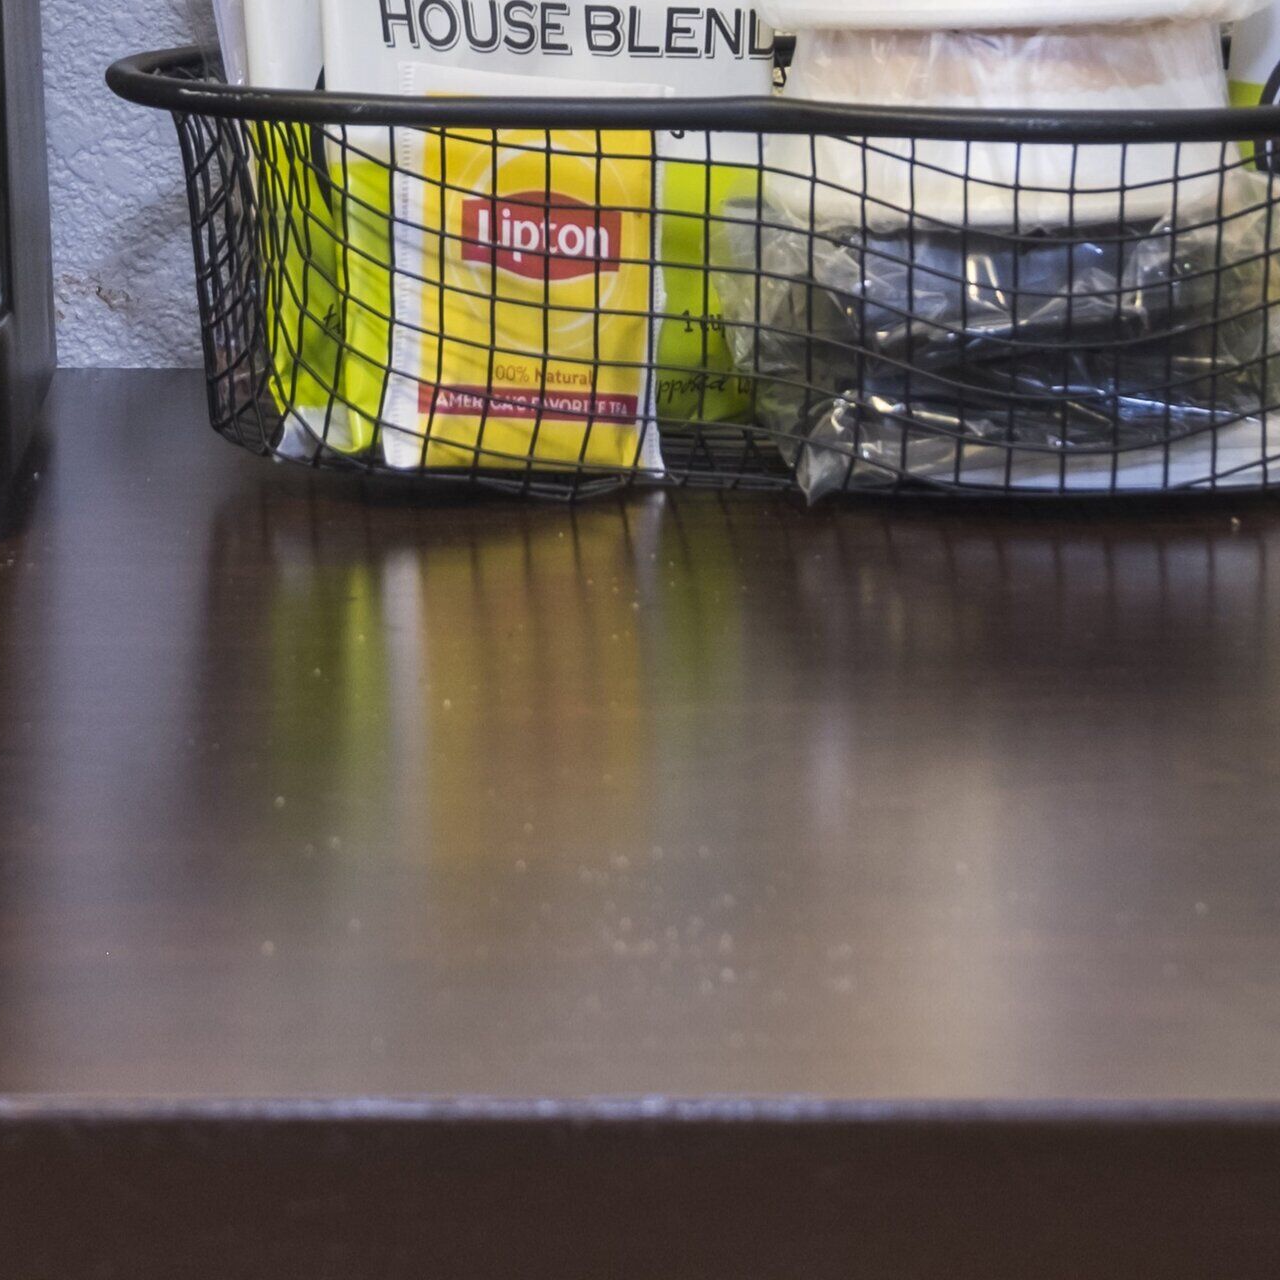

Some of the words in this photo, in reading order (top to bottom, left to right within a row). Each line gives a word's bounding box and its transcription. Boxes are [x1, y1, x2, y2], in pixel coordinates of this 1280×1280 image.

[478, 208, 609, 263] Lipton
[494, 364, 530, 383] 00%
[435, 391, 527, 411] AMERCA'S
[531, 396, 606, 414] FVORIE
